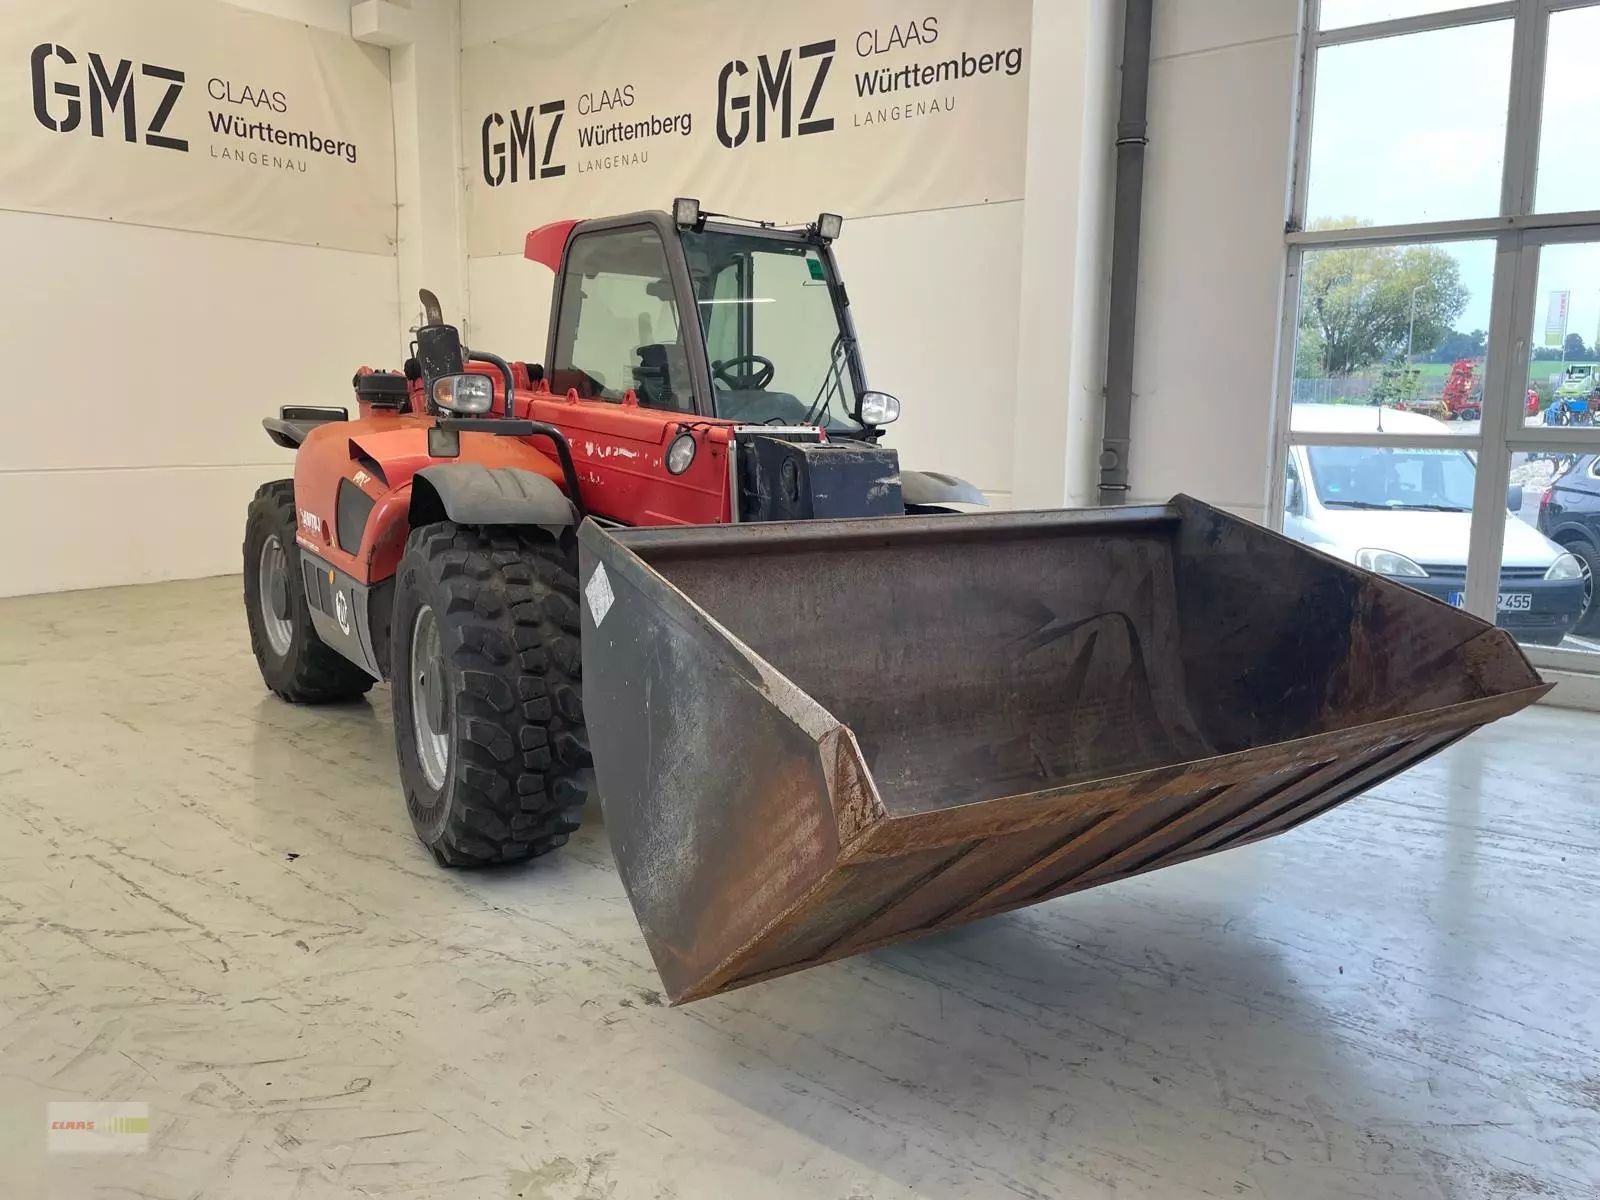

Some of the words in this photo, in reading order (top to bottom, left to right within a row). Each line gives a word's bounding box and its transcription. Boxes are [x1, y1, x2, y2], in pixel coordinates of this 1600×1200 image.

[856, 16, 939, 58] CLAAS
[854, 45, 1023, 98] Württemberg
[31, 43, 190, 153] GMZ
[207, 77, 288, 113] CLAAS
[577, 84, 635, 116] CLAAS
[715, 38, 836, 149] GMZ
[853, 95, 956, 128] LANGENAU
[207, 110, 357, 163] Württemberg
[481, 99, 566, 188] GMZ
[577, 112, 692, 149] Württemberg
[210, 145, 308, 174] LANGENAU
[578, 151, 649, 174] LANGENAU
[1506, 595, 1531, 608] 455
